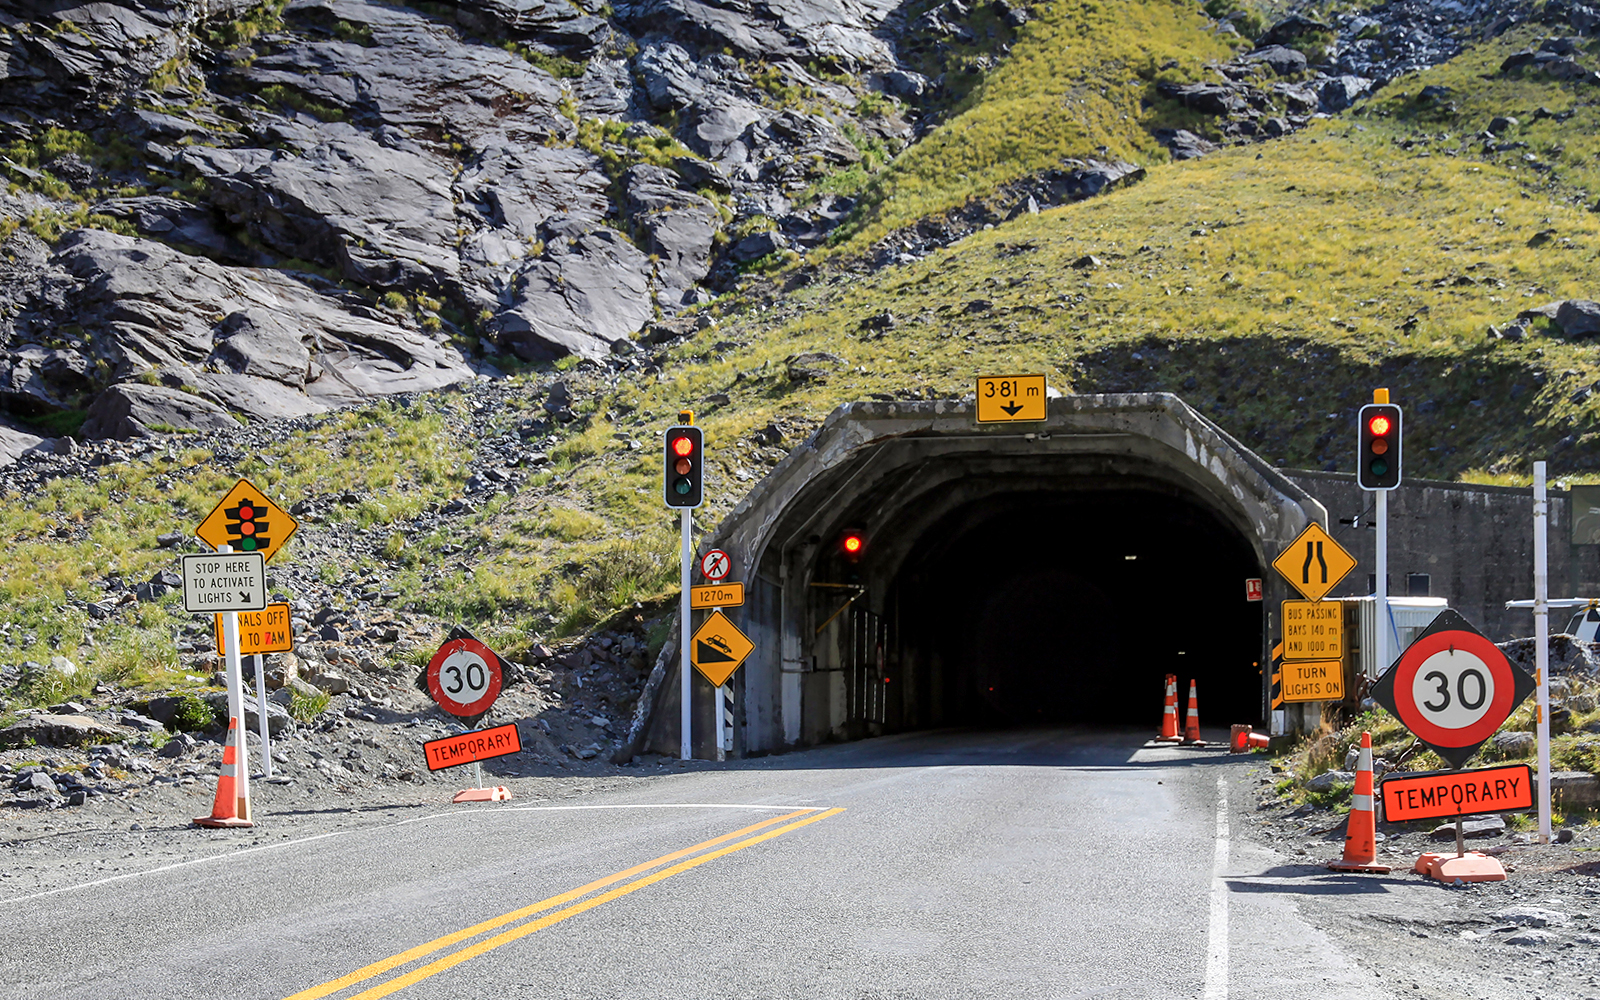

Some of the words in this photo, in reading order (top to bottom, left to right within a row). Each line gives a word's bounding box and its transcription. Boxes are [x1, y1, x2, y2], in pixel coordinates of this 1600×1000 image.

[1026, 386, 1039, 396] m
[195, 562, 220, 574] STOP
[225, 561, 250, 573] HERE
[193, 578, 205, 589] TO
[211, 576, 254, 588] ACTIVATE
[198, 592, 232, 604] LIGHTS
[700, 589, 733, 602] 1270m
[267, 611, 284, 625] OFF
[1288, 608, 1302, 620] BUS
[1306, 608, 1337, 620] PASSING
[1288, 625, 1306, 636] BAYS
[1311, 624, 1324, 636] 140
[1328, 627, 1337, 635] m
[248, 632, 260, 646] TO
[265, 630, 286, 646] 7AM
[1288, 641, 1302, 652] AND
[1307, 641, 1324, 652] 1000
[1329, 643, 1338, 651] m
[445, 663, 485, 694] 30
[1297, 667, 1326, 679] TURN
[1285, 683, 1320, 696] LIGHTS
[1326, 682, 1340, 694] ON
[1423, 668, 1486, 713] 30
[432, 732, 512, 762] TEMPORARY
[1394, 777, 1520, 810] TEMPORARY
